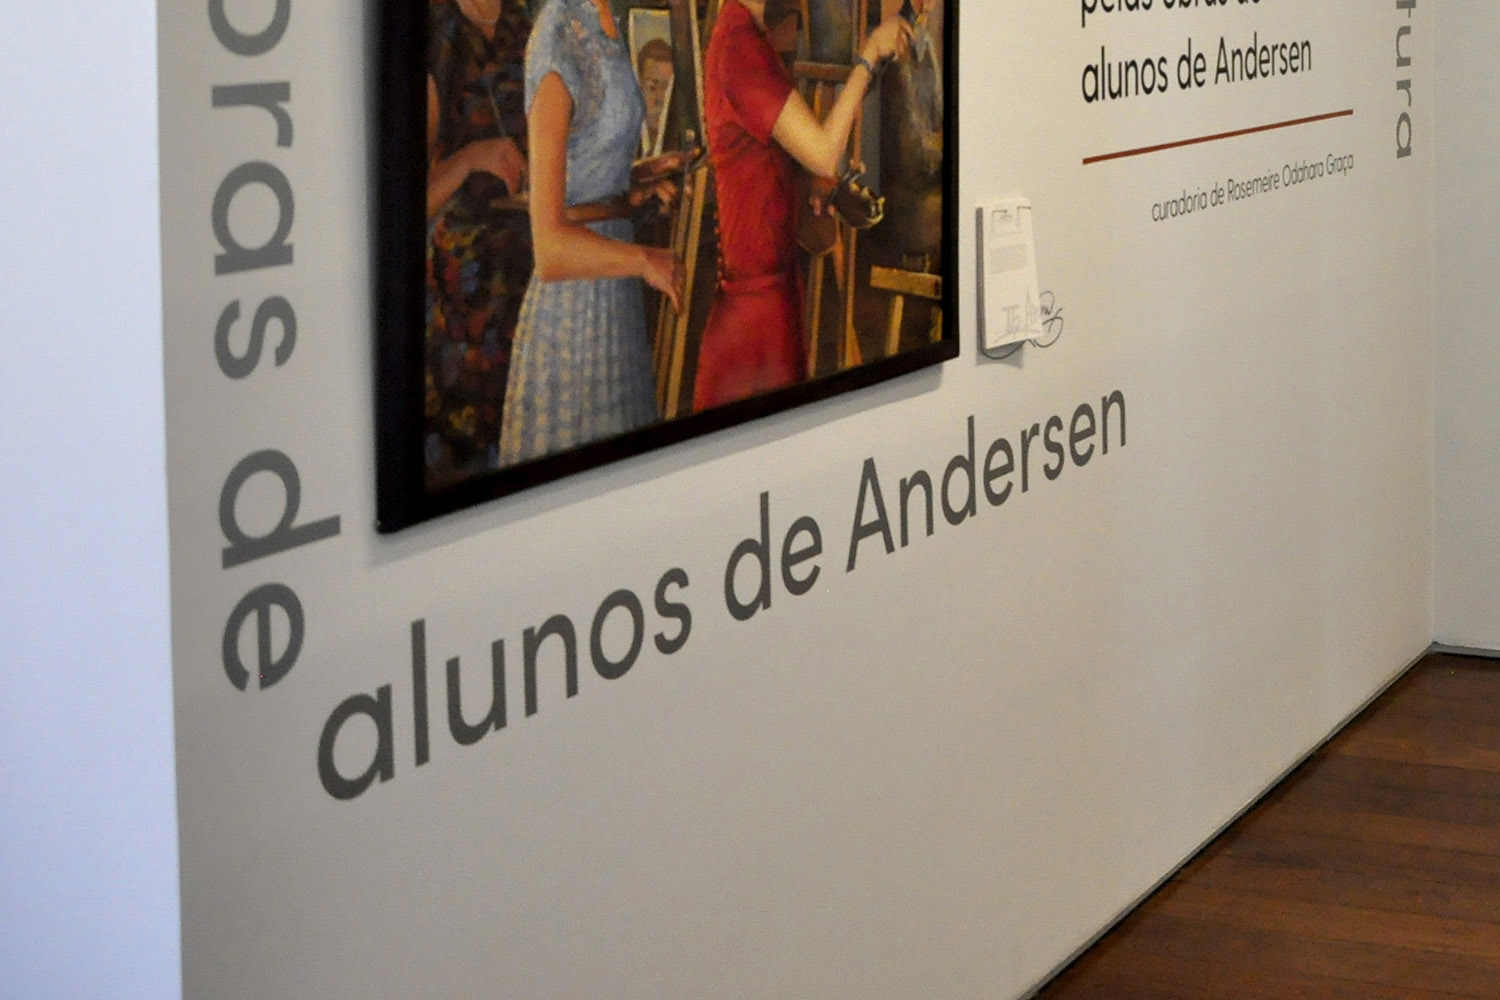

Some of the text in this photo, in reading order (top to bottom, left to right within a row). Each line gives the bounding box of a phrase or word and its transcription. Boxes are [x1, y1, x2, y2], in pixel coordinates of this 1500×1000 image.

[1082, 31, 1312, 104] alunos de Andersen
[1152, 188, 1208, 222] curadoria
[1209, 182, 1225, 207] de
[1227, 169, 1280, 202] Rosemeire
[217, 449, 341, 693] de
[317, 389, 1127, 801] alunos de Andersen
